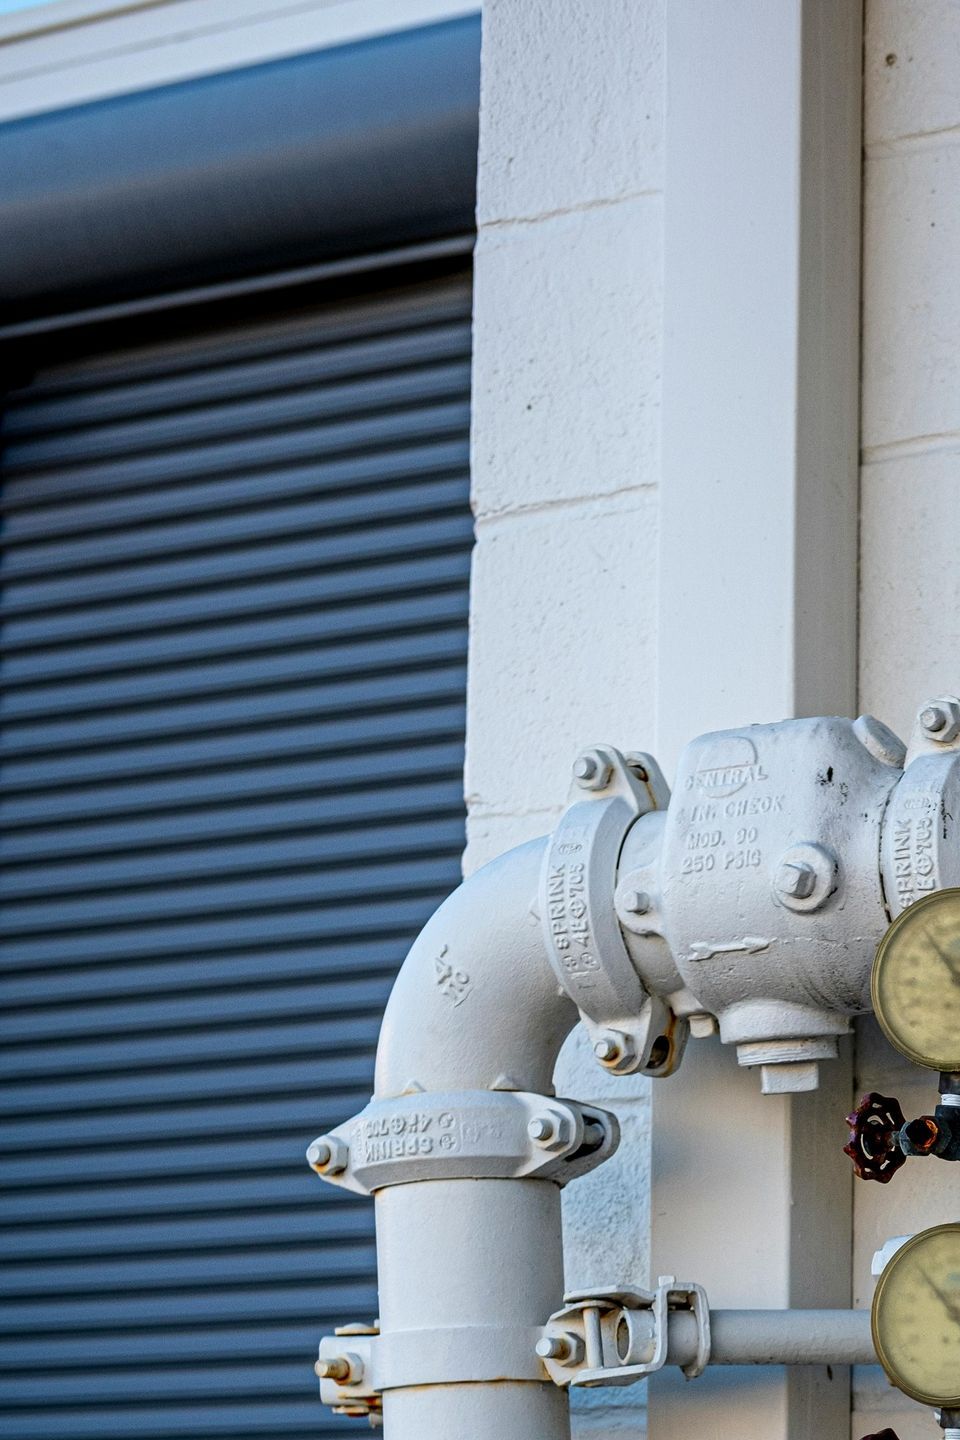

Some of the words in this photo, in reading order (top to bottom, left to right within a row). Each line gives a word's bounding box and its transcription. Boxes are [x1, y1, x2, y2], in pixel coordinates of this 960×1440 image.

[684, 764, 768, 791] CENTRAL
[725, 794, 785, 818] CHECK
[682, 854, 715, 875] 250
[549, 863, 571, 950] SPRINK
[366, 1136, 433, 1162] SPRINK
